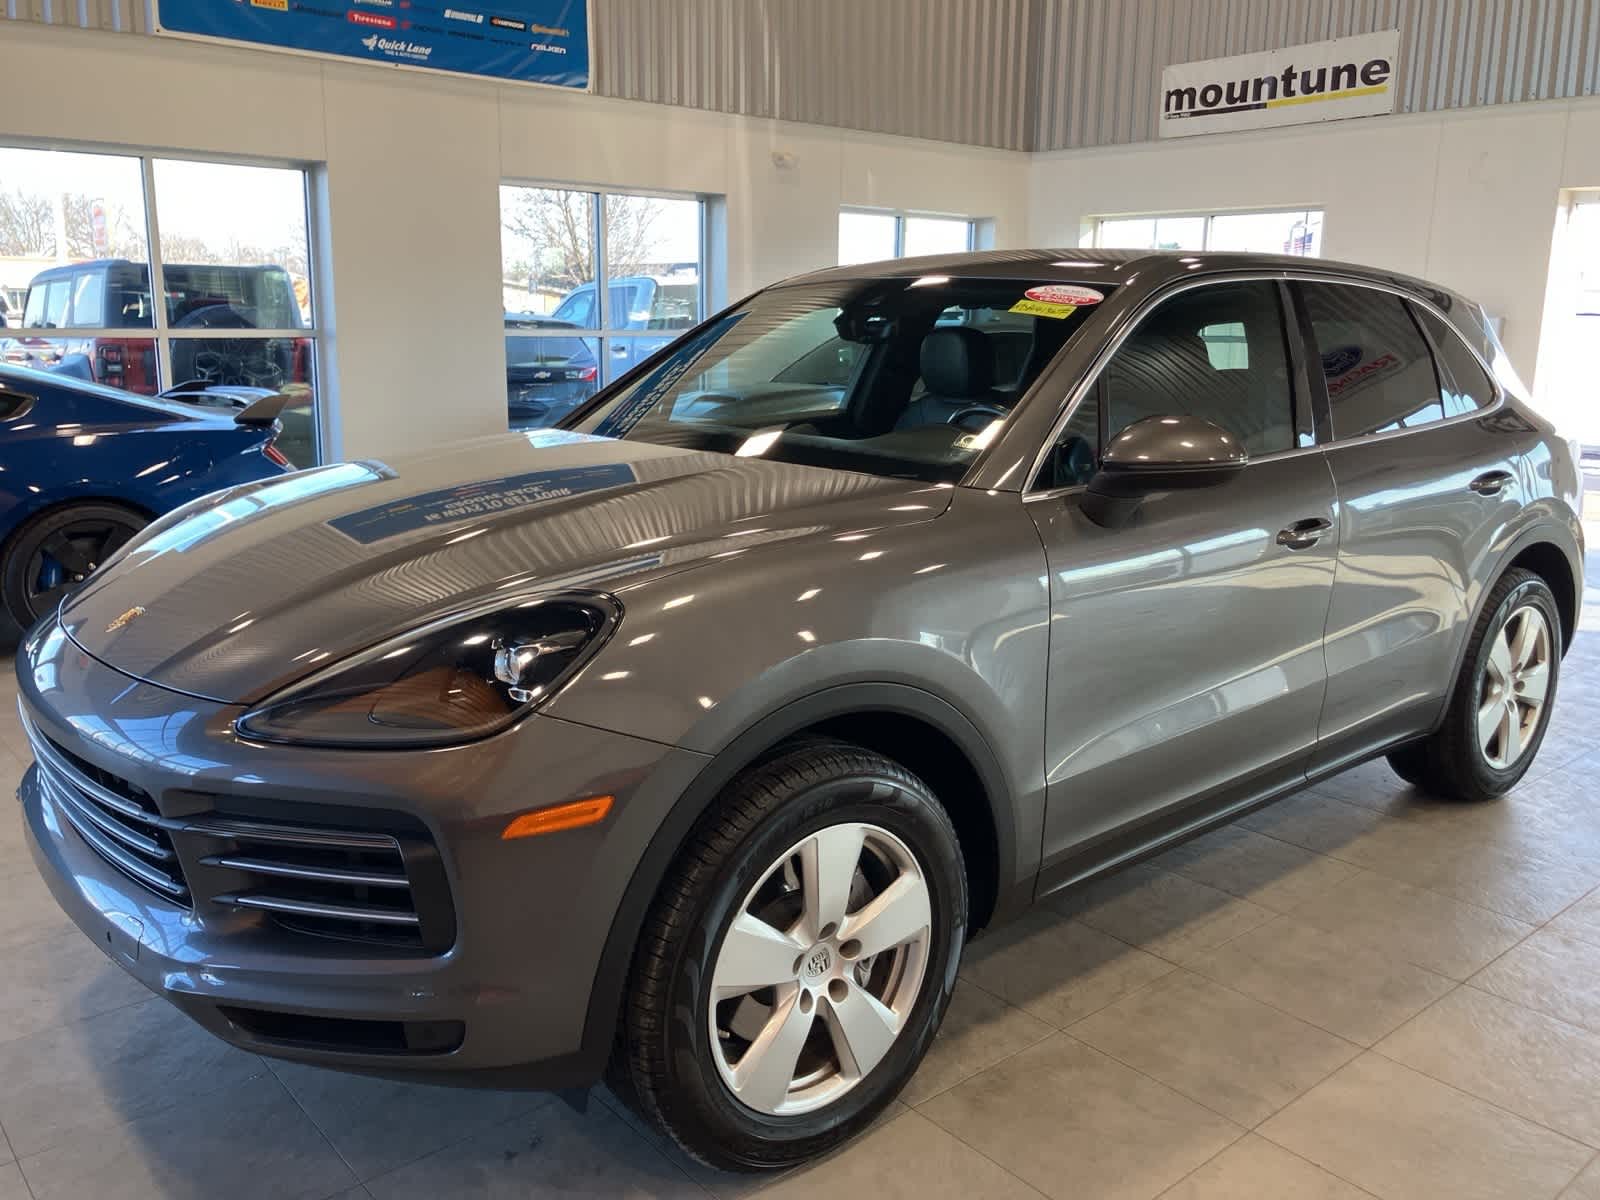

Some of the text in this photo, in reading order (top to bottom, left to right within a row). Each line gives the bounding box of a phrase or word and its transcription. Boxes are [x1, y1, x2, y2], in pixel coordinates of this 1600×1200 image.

[378, 38, 407, 51] Quick
[406, 42, 432, 55] Lane
[531, 43, 566, 54] FALKEN
[1165, 58, 1391, 112] mountune
